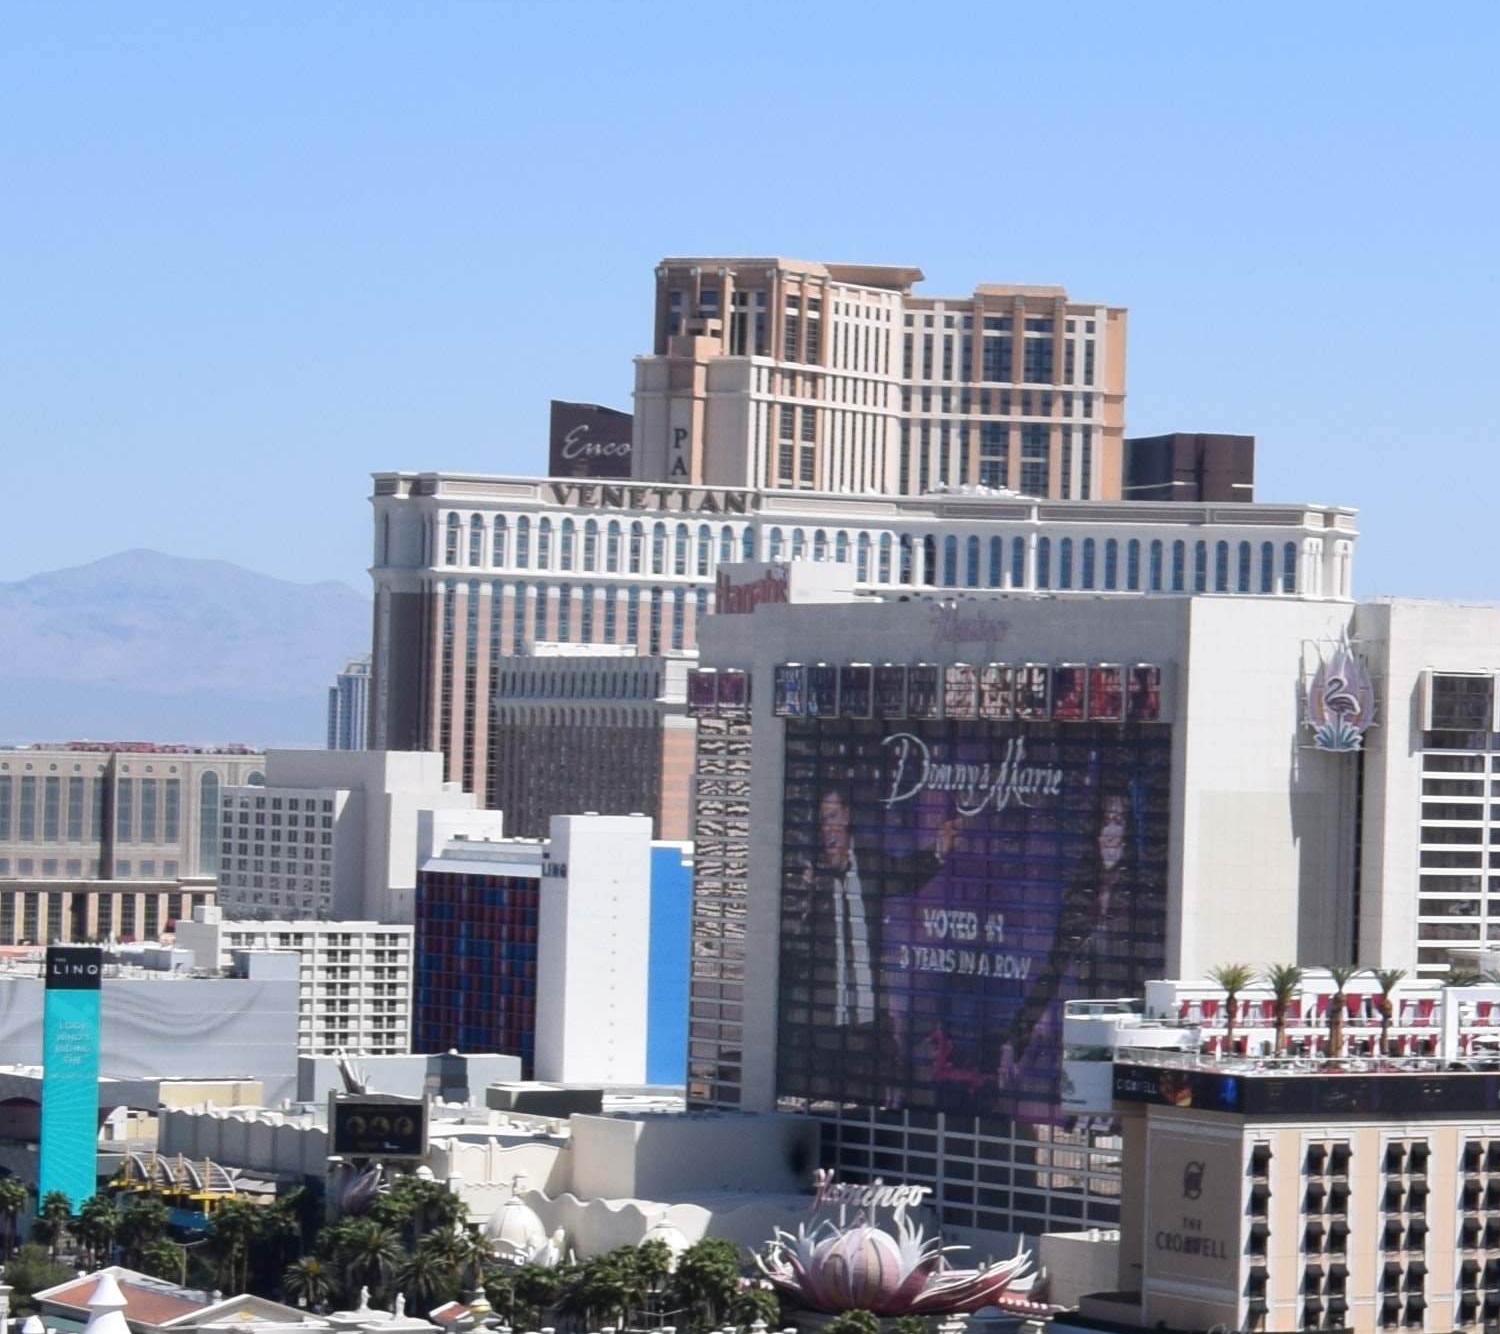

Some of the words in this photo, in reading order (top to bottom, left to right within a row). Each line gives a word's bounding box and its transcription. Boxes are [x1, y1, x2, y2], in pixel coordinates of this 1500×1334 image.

[550, 483, 748, 514] VENETIAN
[878, 733, 979, 809] Donny
[956, 734, 1063, 816] Marie
[923, 908, 978, 940] VOTED
[53, 964, 98, 975] LINQ
[900, 944, 909, 969] 3
[912, 946, 954, 973] YEARS
[957, 950, 975, 974] IN
[977, 953, 989, 976] A
[993, 954, 1032, 980] ROW
[813, 1168, 933, 1223] Flamingo
